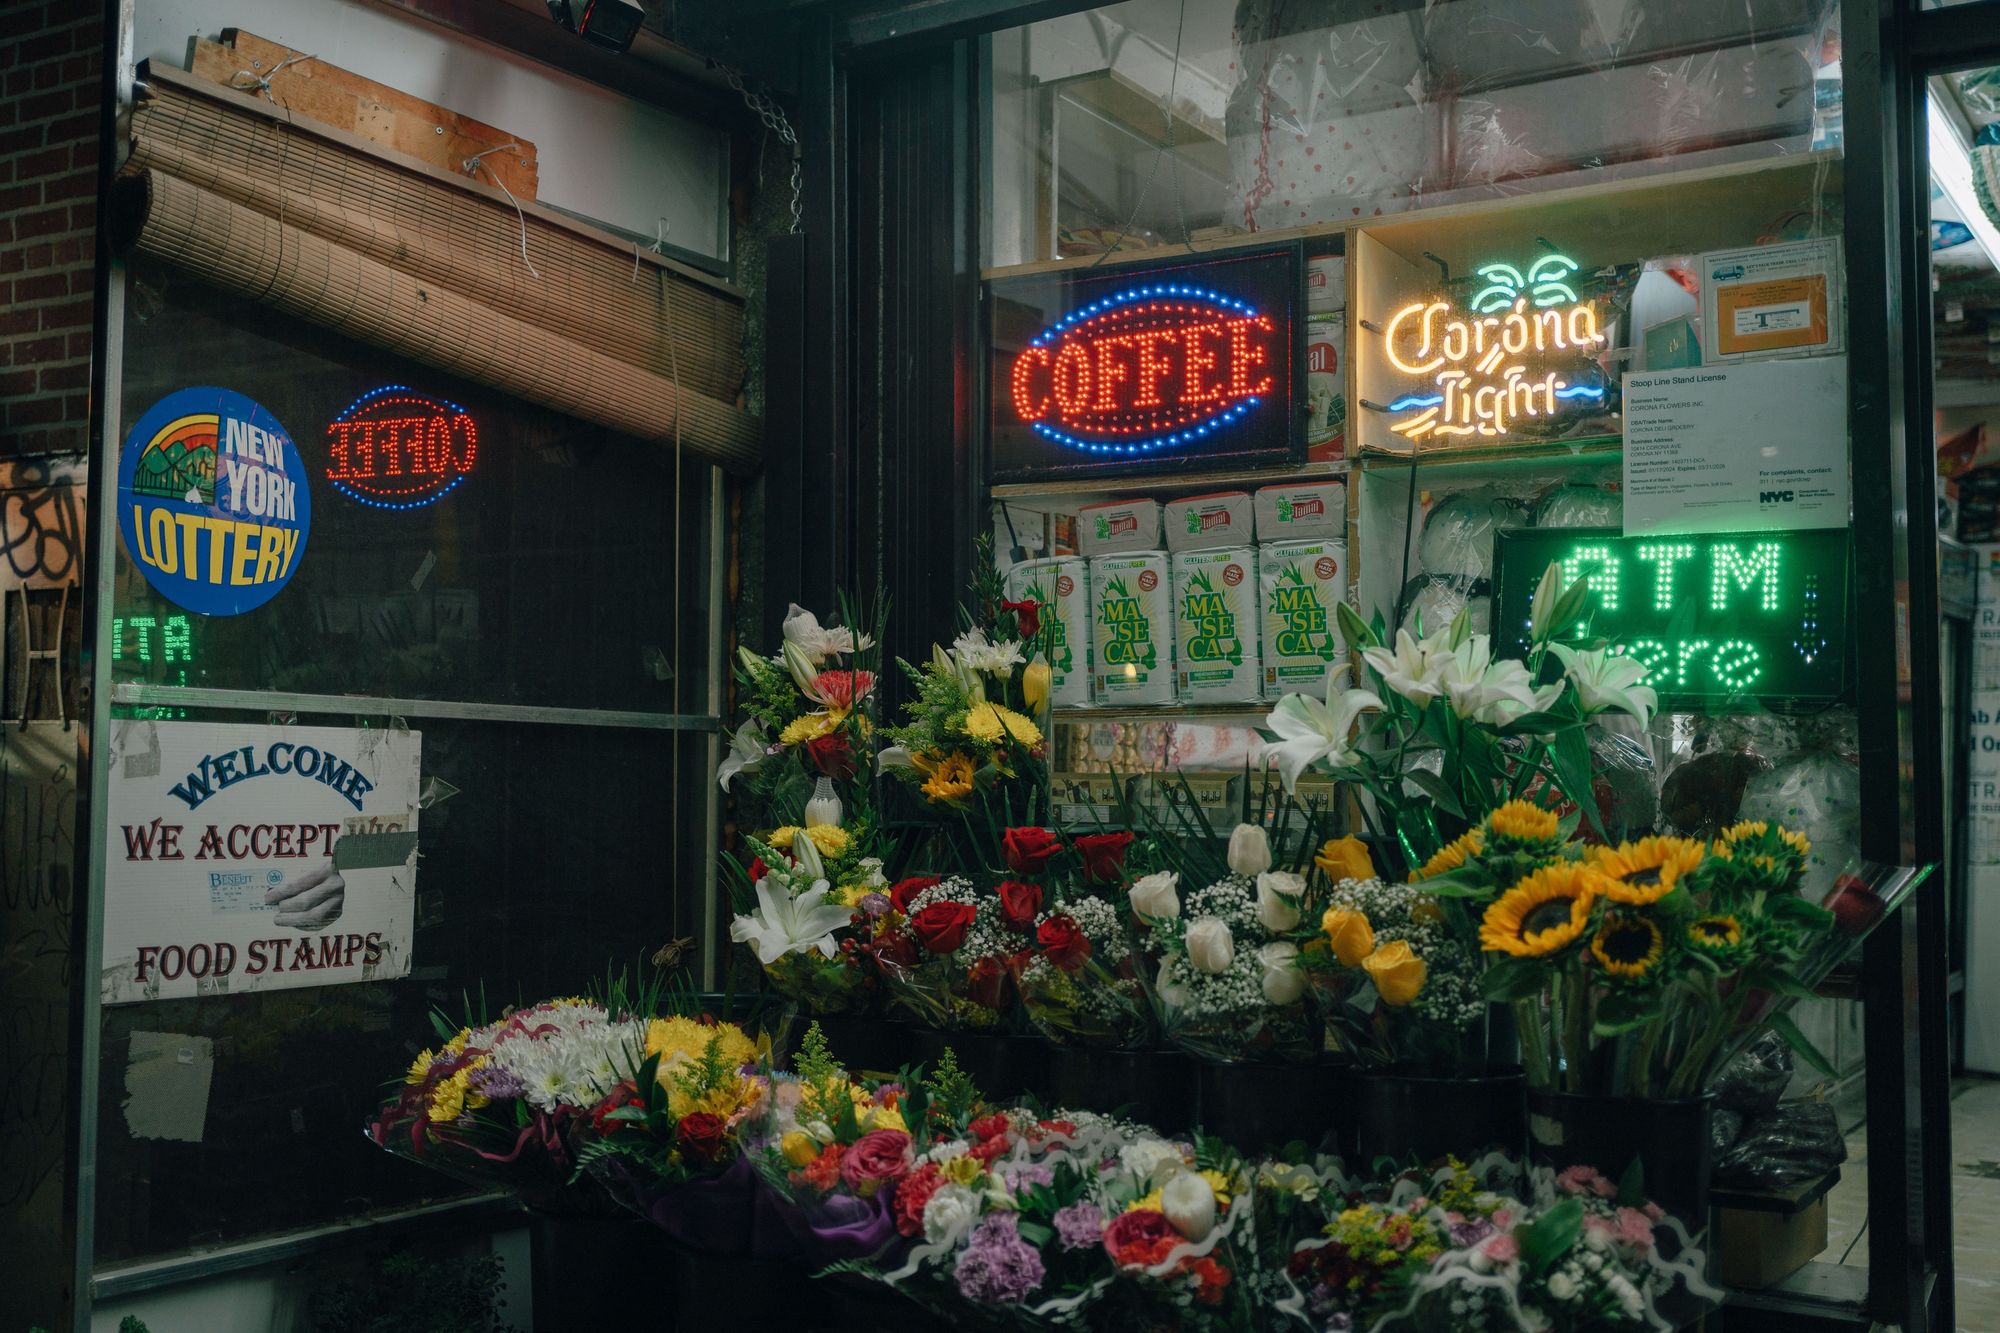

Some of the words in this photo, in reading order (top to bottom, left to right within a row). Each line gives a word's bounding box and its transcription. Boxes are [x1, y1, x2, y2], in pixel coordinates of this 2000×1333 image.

[1011, 315, 1275, 421] COFFEE
[1630, 380, 1652, 388] Stoop
[1654, 378, 1670, 386] Line
[1672, 376, 1695, 384] Stand
[1696, 374, 1726, 382] License
[1434, 365, 1566, 436] Light
[225, 417, 284, 471] NEW
[226, 459, 296, 521] YORK
[1760, 491, 1794, 503] NYC
[134, 504, 300, 586] LOTTERY
[1563, 543, 1781, 610] ATM
[1189, 595, 1225, 617] MA
[1279, 589, 1316, 610] MA
[1107, 601, 1139, 621] MA
[1292, 610, 1324, 632] SE
[1118, 622, 1147, 641] SE
[1202, 616, 1232, 638] SE
[1106, 642, 1137, 662] CA
[1189, 638, 1221, 660] CA
[1278, 632, 1312, 654] CA
[167, 741, 374, 812] WELCOME
[121, 816, 185, 862] WE
[194, 823, 340, 860] ACCEPT
[134, 942, 237, 983] FOOD
[244, 932, 384, 975] STAMPS
